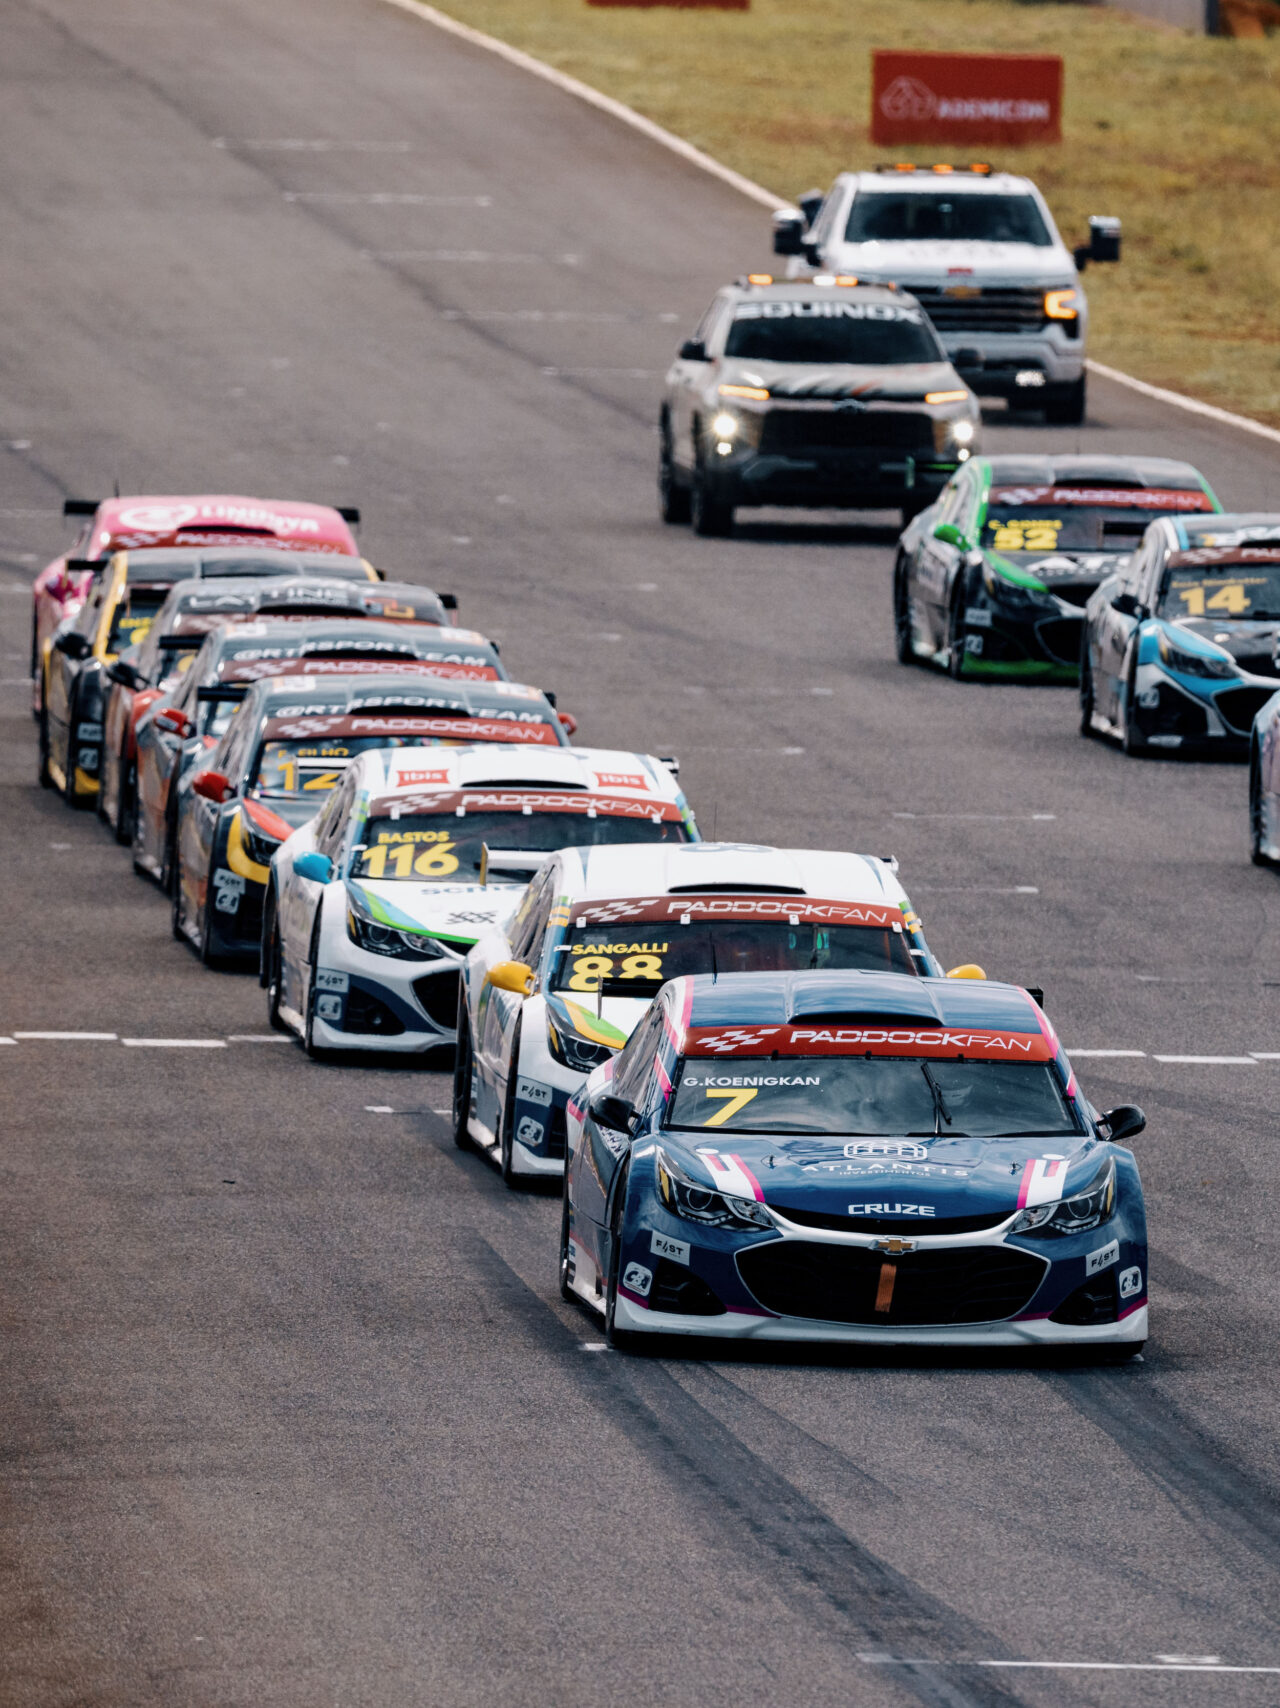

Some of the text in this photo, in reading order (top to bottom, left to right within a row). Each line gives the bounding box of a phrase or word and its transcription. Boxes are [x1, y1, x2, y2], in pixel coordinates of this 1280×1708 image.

[736, 302, 923, 325] EQUINOX
[994, 528, 1058, 549] 52
[1179, 585, 1252, 615] 14
[303, 660, 488, 681] PADDOCKFAN
[351, 717, 545, 740] PADDOCKFAN
[403, 770, 443, 783] ibis
[607, 773, 642, 786] ibis
[461, 794, 665, 817] PADDOCKFAN
[378, 831, 450, 844] BASTOS
[362, 842, 460, 878] 116
[667, 900, 888, 923] PADDOCKFAN
[571, 942, 668, 955] SANGALLI
[569, 954, 663, 992] 88
[790, 1030, 1032, 1052] PADDOCKFAN
[683, 1076, 821, 1087] G.KOENIGKAN
[703, 1088, 759, 1126] 7
[801, 1163, 969, 1177] ATLANTIS
[847, 1203, 936, 1216] CRUZE
